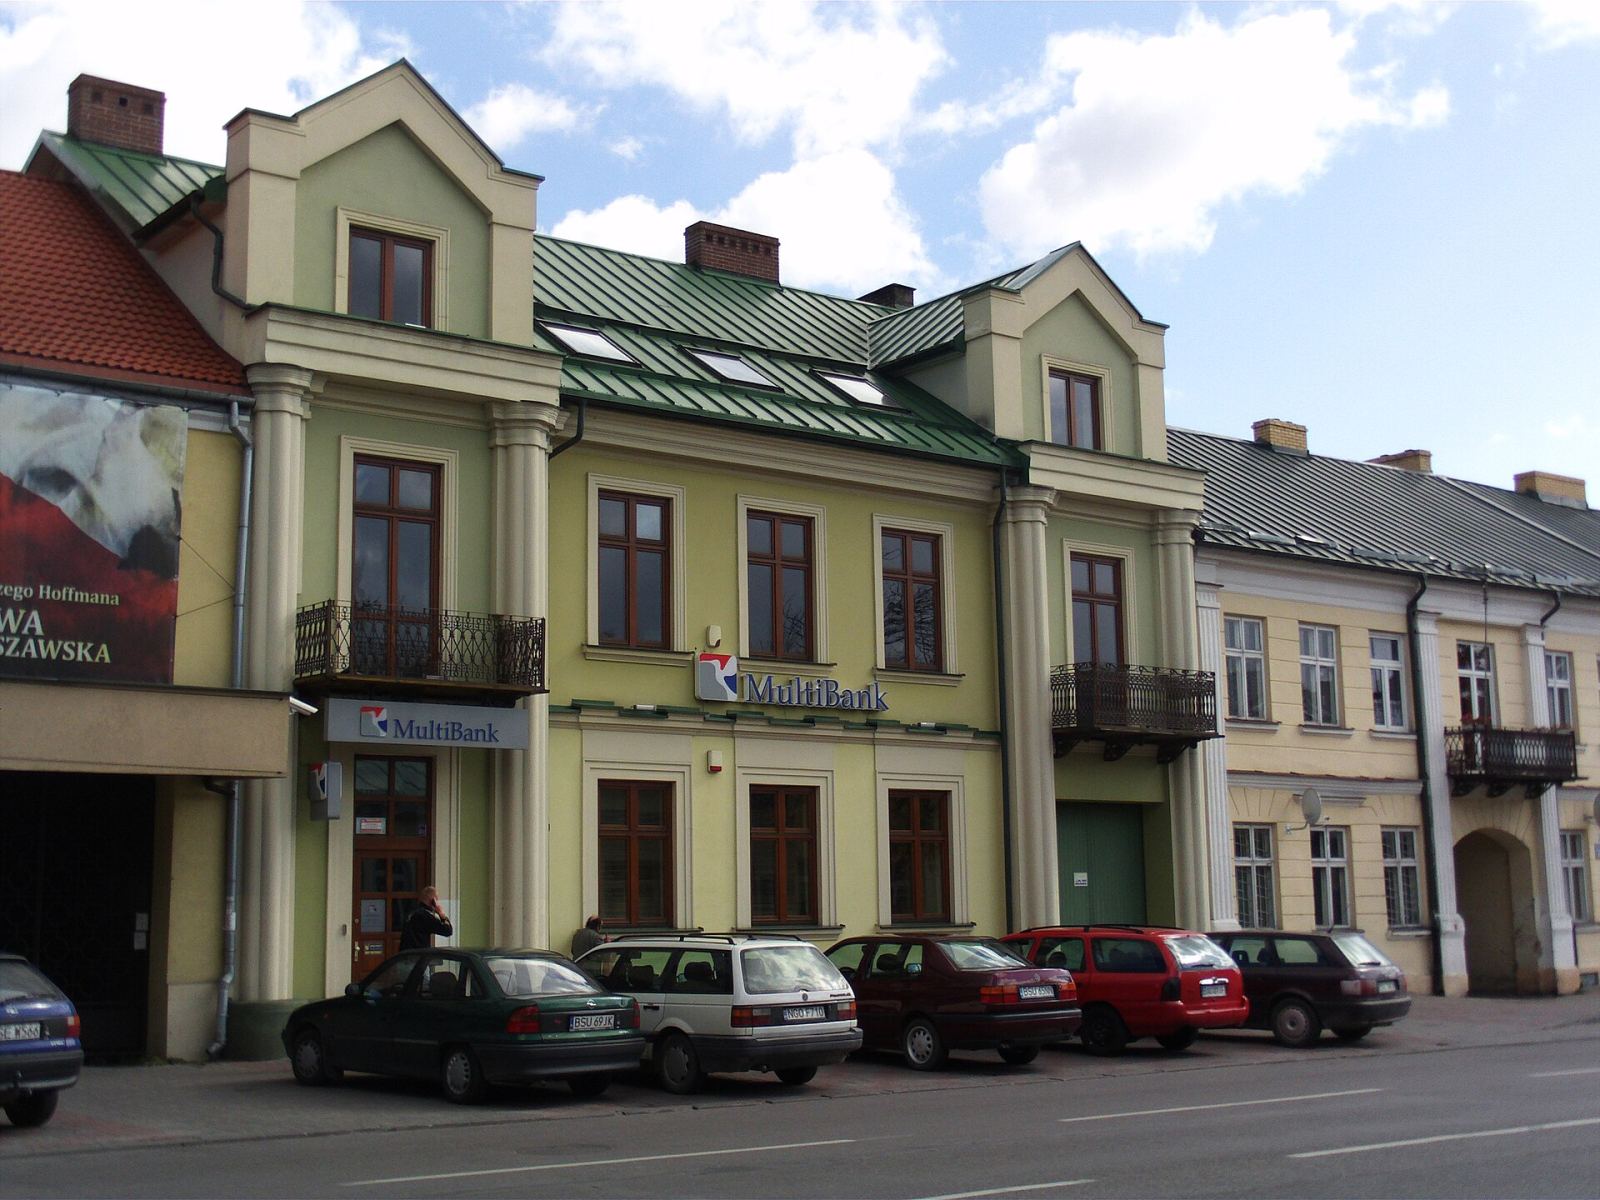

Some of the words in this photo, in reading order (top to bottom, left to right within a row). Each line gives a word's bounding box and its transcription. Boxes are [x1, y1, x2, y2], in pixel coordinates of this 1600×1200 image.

[39, 585, 119, 605] Hoffmana
[0, 607, 44, 636] WA
[744, 673, 889, 710] MultiBank
[393, 718, 499, 742] MultiBank
[574, 1016, 593, 1028] BSU
[593, 1014, 613, 1027] 69JK
